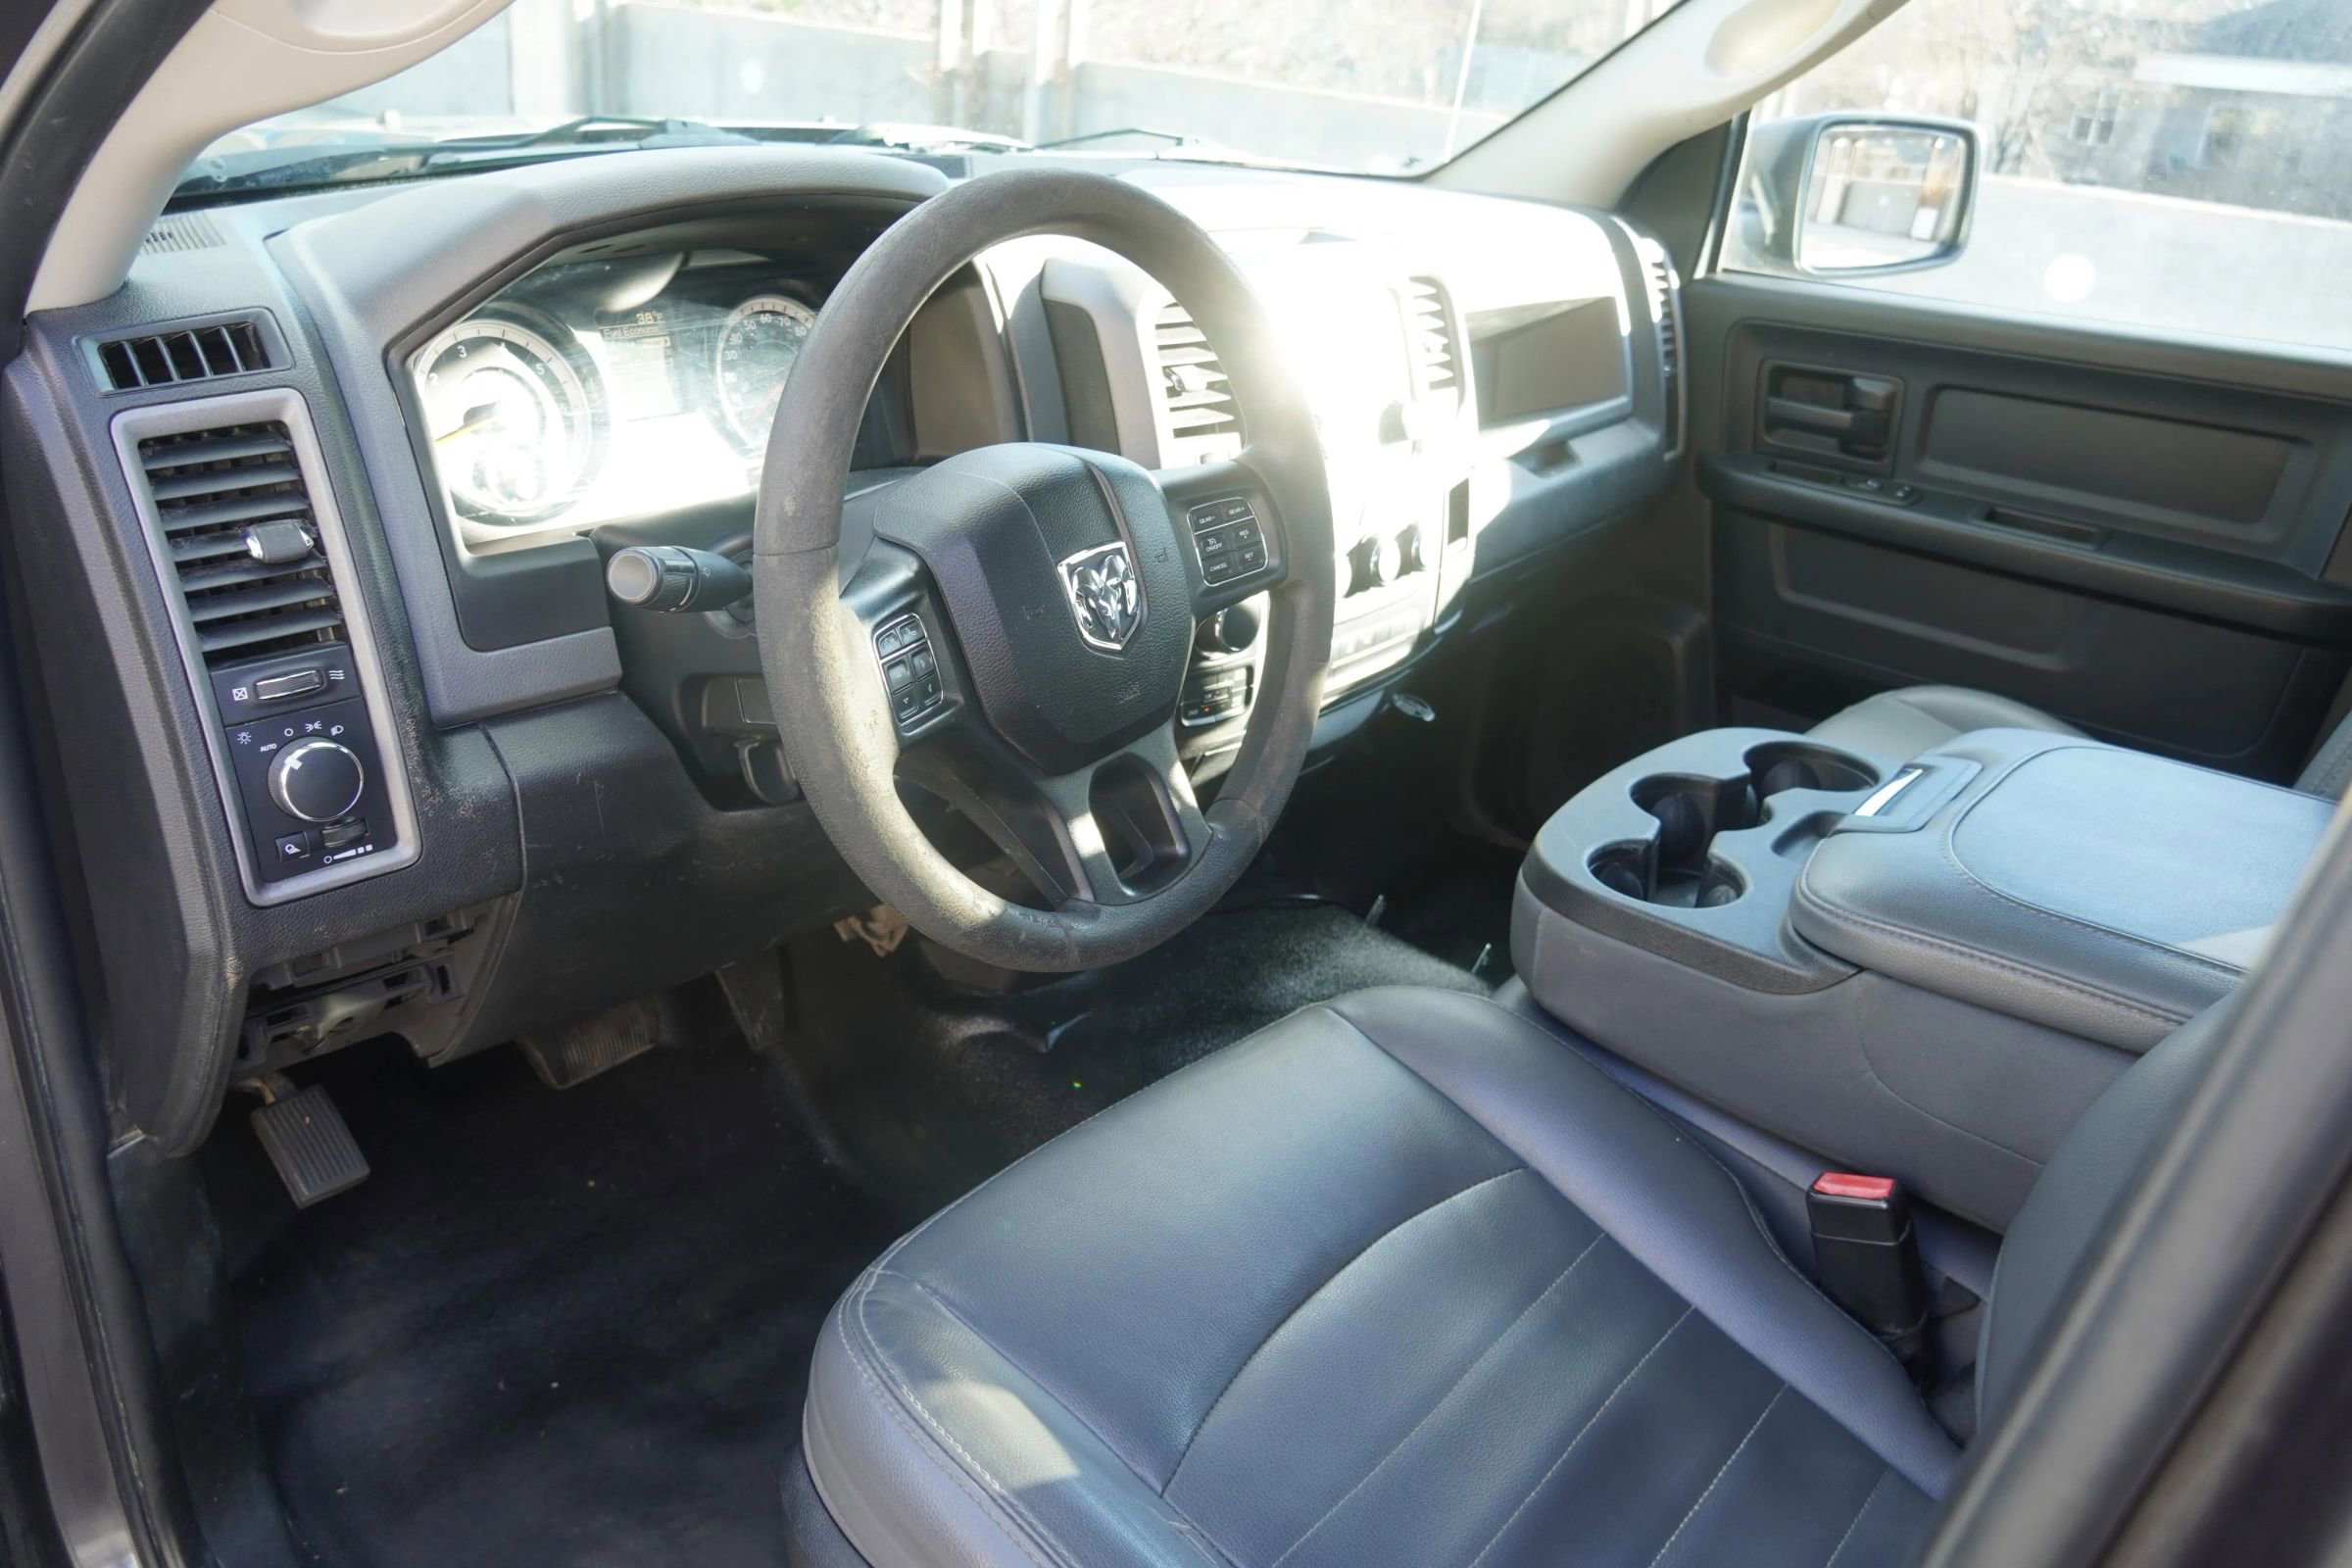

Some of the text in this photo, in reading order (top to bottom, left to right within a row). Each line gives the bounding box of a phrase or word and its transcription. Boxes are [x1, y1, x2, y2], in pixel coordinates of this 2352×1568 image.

[760, 314, 772, 323] 60
[744, 320, 757, 329] 50
[457, 345, 467, 358] 3
[725, 350, 738, 361] 30
[535, 364, 545, 375] 5
[428, 373, 440, 385] 2
[1209, 563, 1228, 572] CANCEL
[260, 743, 277, 753] AUTO
